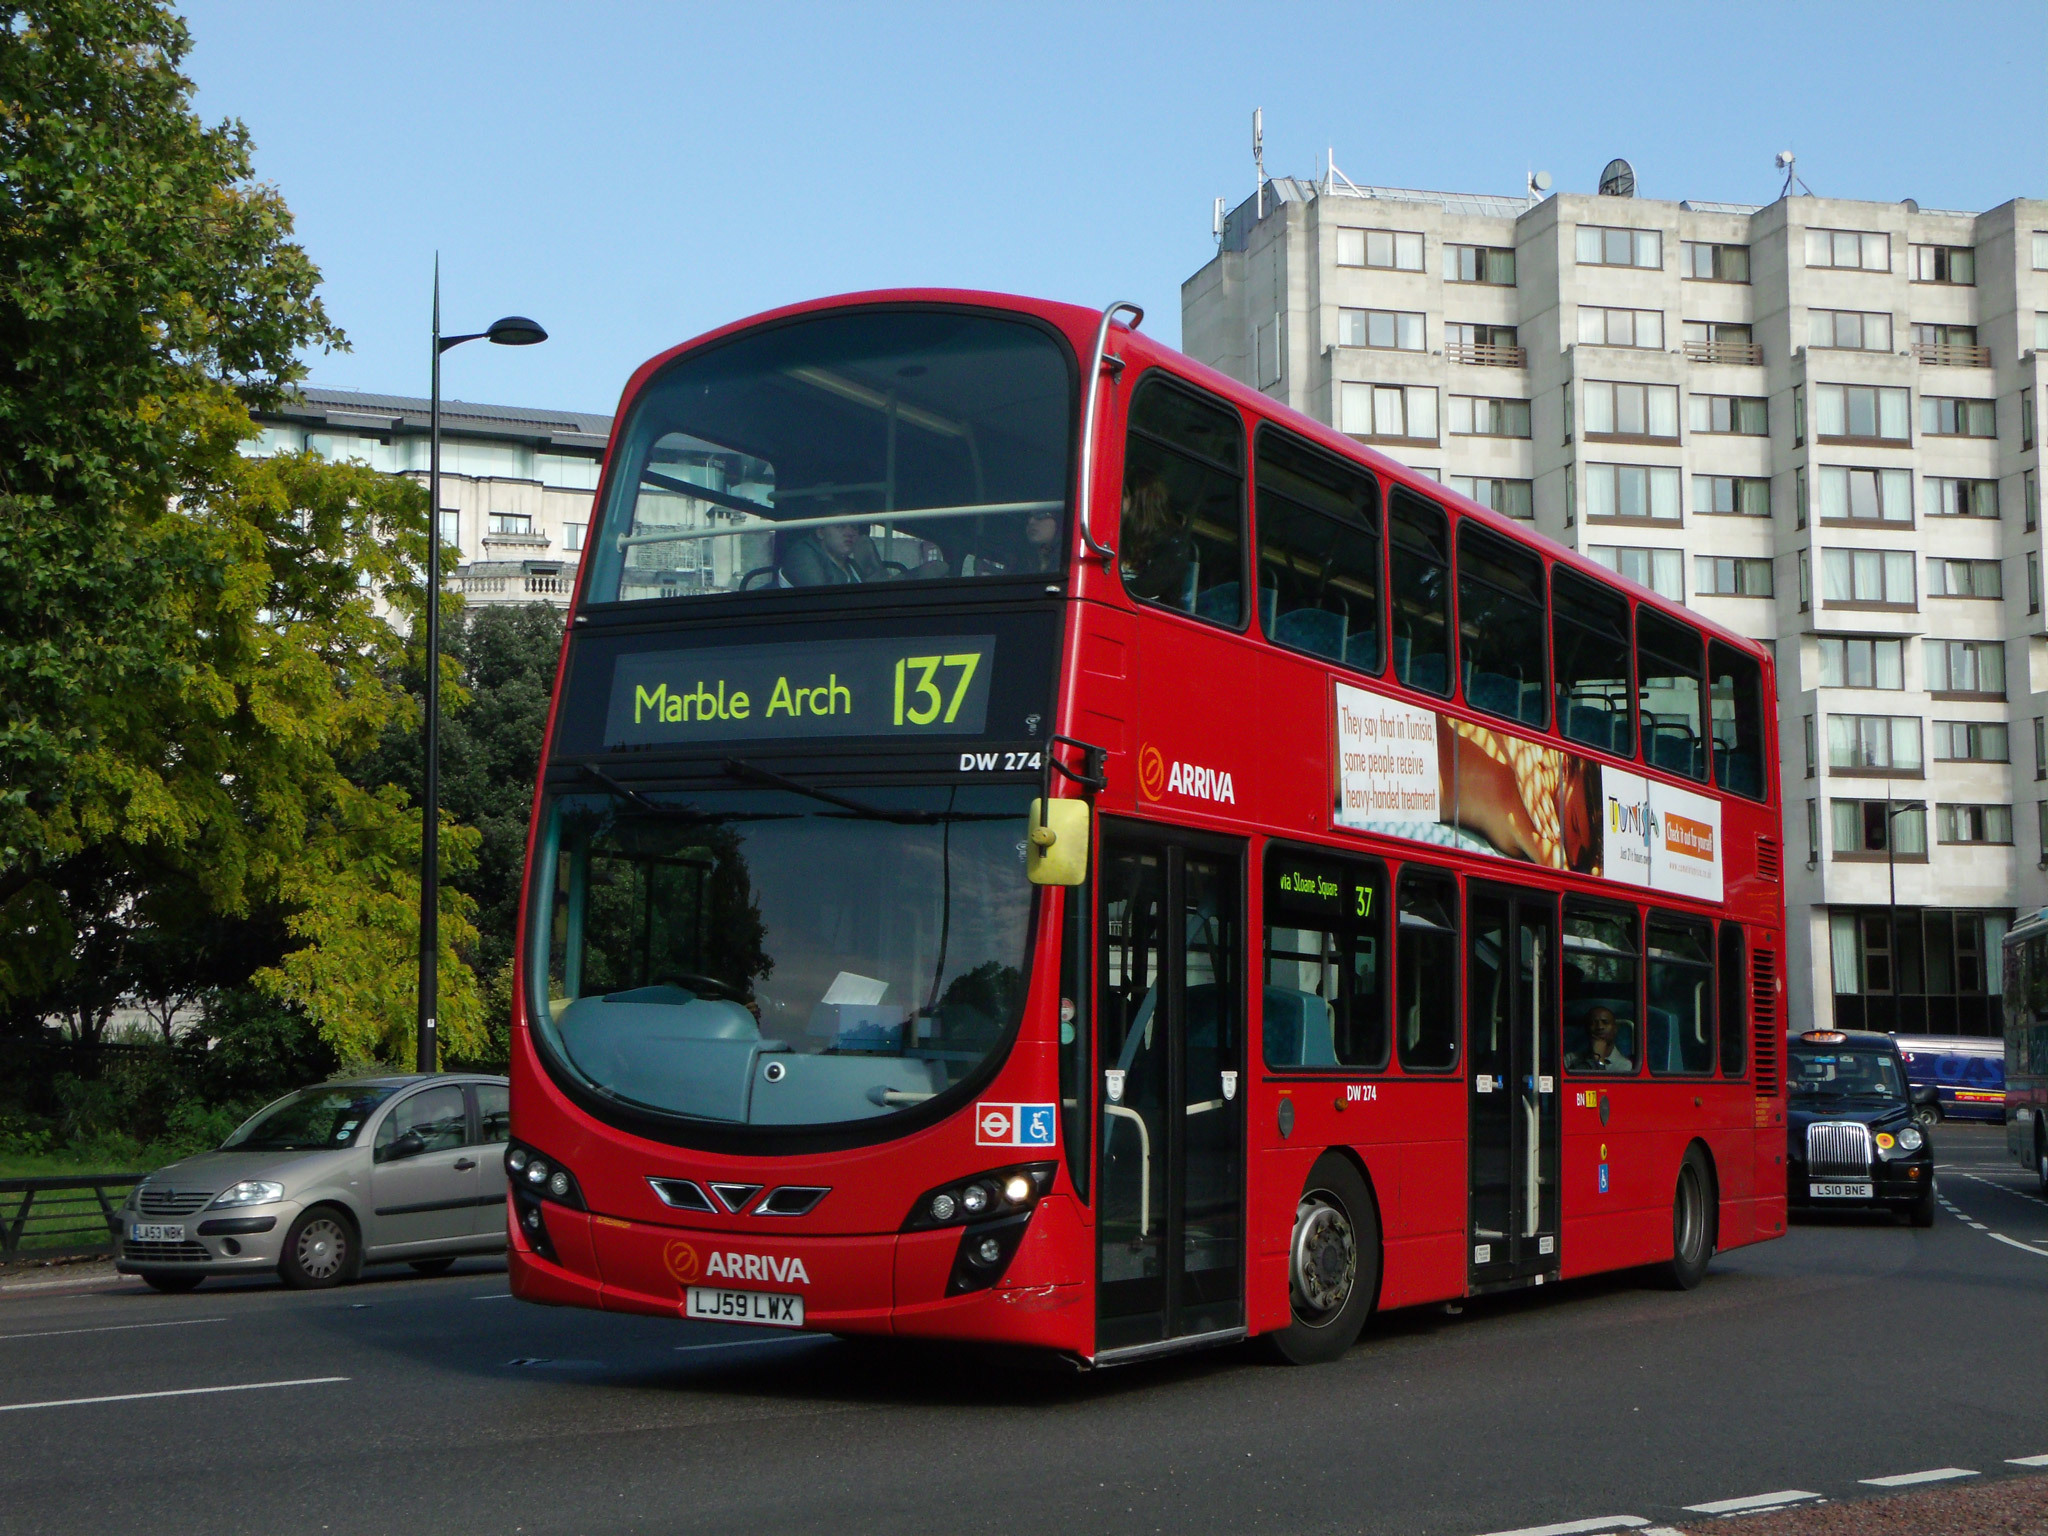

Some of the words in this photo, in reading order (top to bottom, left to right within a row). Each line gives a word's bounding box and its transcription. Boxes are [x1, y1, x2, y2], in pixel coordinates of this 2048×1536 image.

[634, 680, 750, 724] Marble
[765, 673, 851, 718] Arch
[893, 652, 982, 726] 137
[1341, 705, 1362, 742] They
[1365, 717, 1378, 743] say
[1380, 708, 1395, 738] that
[1397, 714, 1405, 739] in
[1405, 713, 1435, 747] Tunisia,
[960, 753, 999, 771] DW
[1004, 752, 1042, 770] 274
[1344, 752, 1366, 772] some
[1368, 745, 1395, 780] people
[1396, 751, 1424, 775] receive
[1167, 761, 1236, 805] ARRIVA
[1345, 778, 1399, 816] heavy-handed
[1401, 787, 1436, 811] treatment
[1280, 874, 1291, 890] via
[1293, 871, 1316, 893] Sloane
[1317, 875, 1338, 900] Square
[1347, 1085, 1361, 1101] DW
[1363, 1085, 1377, 1101] 274
[1576, 1092, 1585, 1106] BN
[1817, 1185, 1842, 1195] LS10
[1845, 1185, 1866, 1196] BNE
[706, 1251, 811, 1284] ARRIVA
[695, 1291, 748, 1317] LJ59
[753, 1296, 795, 1321] LWX
